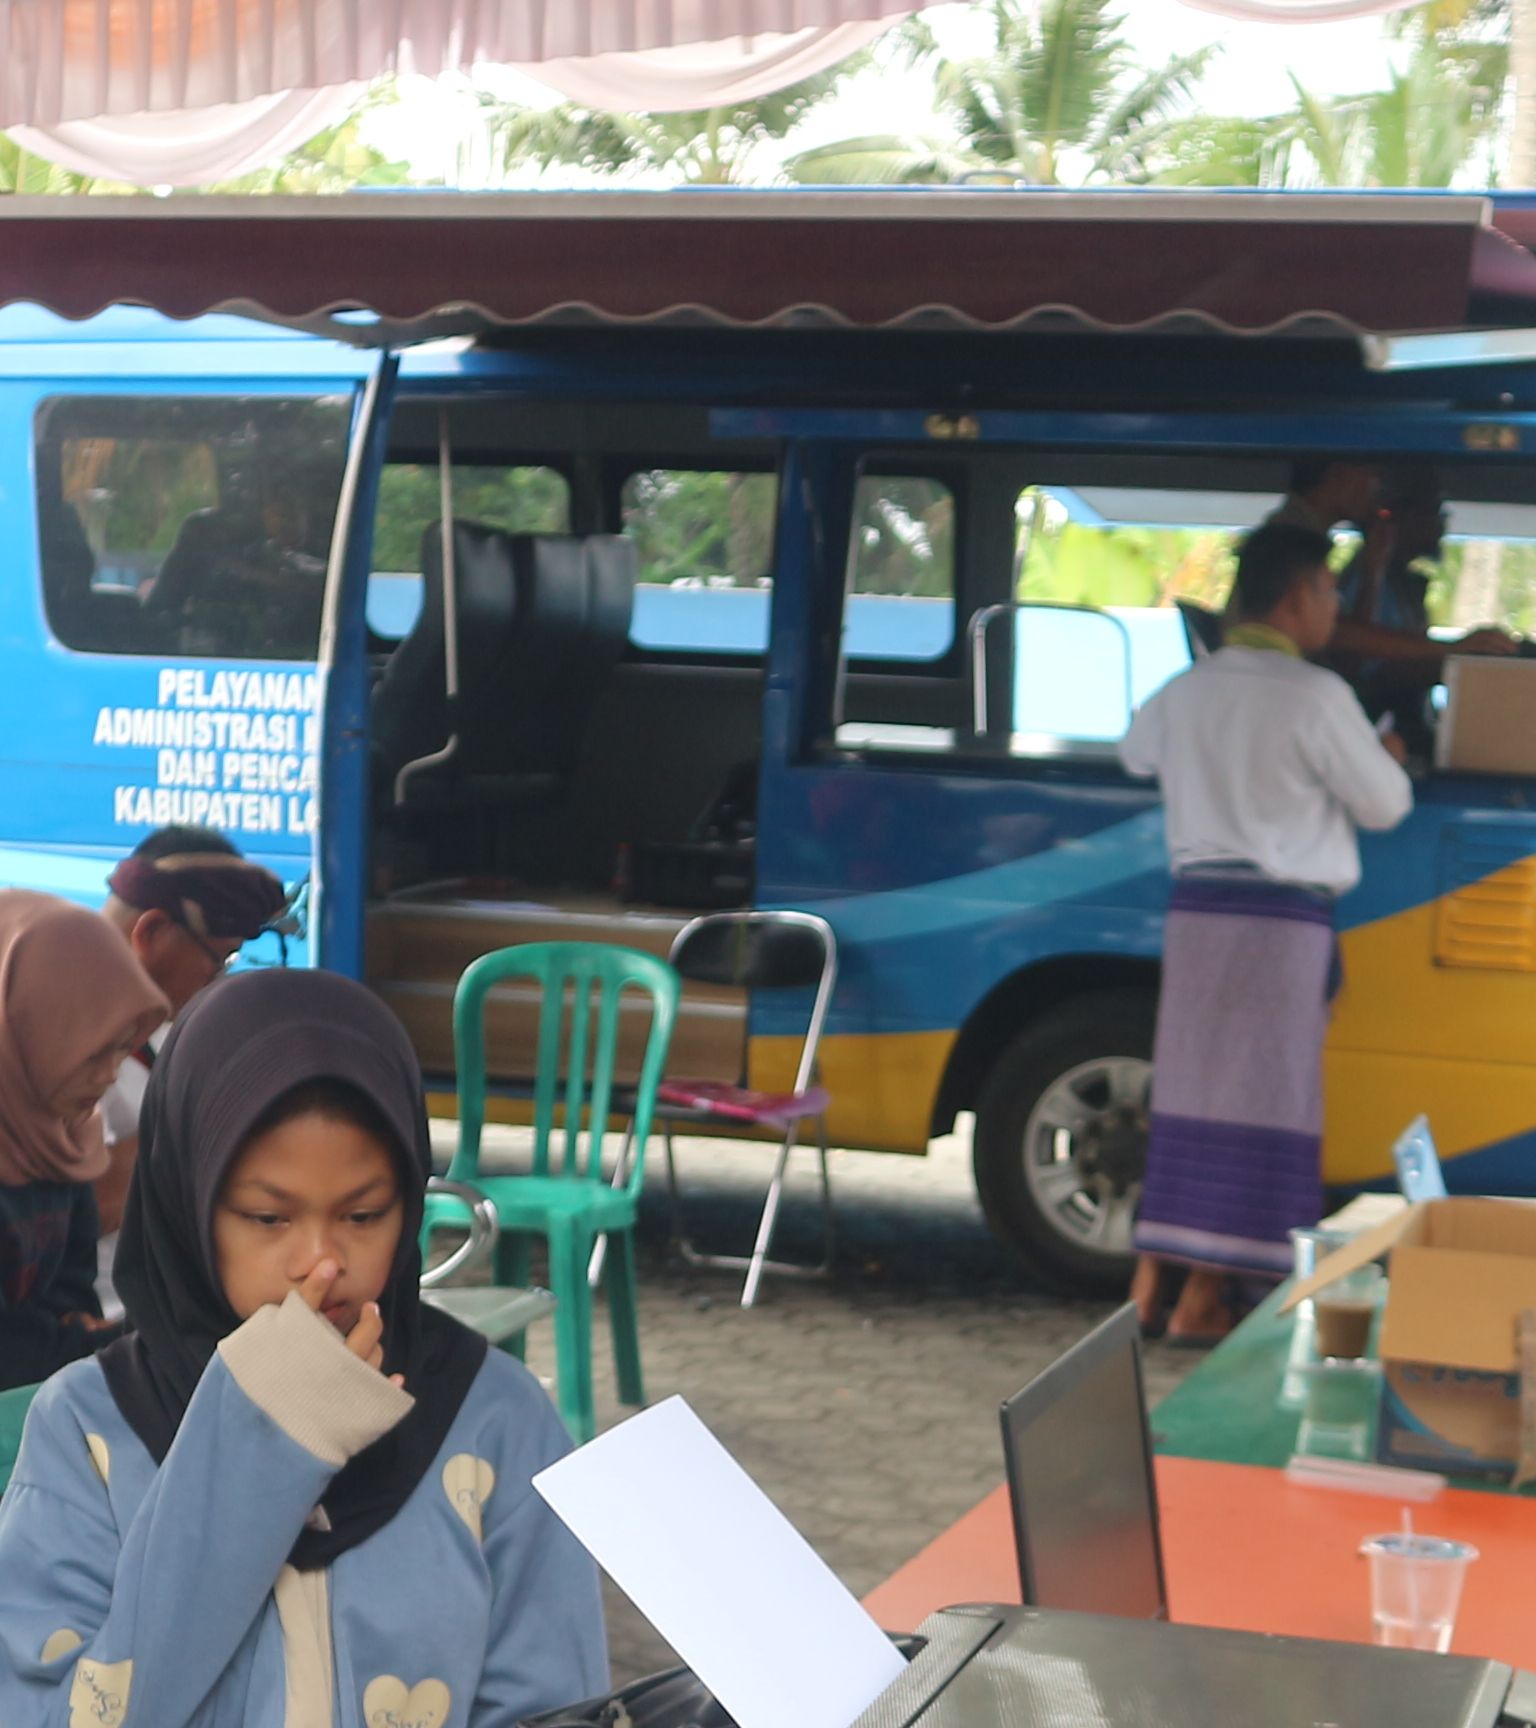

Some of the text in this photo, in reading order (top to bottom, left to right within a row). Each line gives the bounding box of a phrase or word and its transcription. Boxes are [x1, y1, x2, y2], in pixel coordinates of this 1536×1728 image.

[93, 706, 297, 751] ADMINISTRASI
[157, 747, 217, 787] DAN
[114, 785, 282, 832] KABUPATEN
